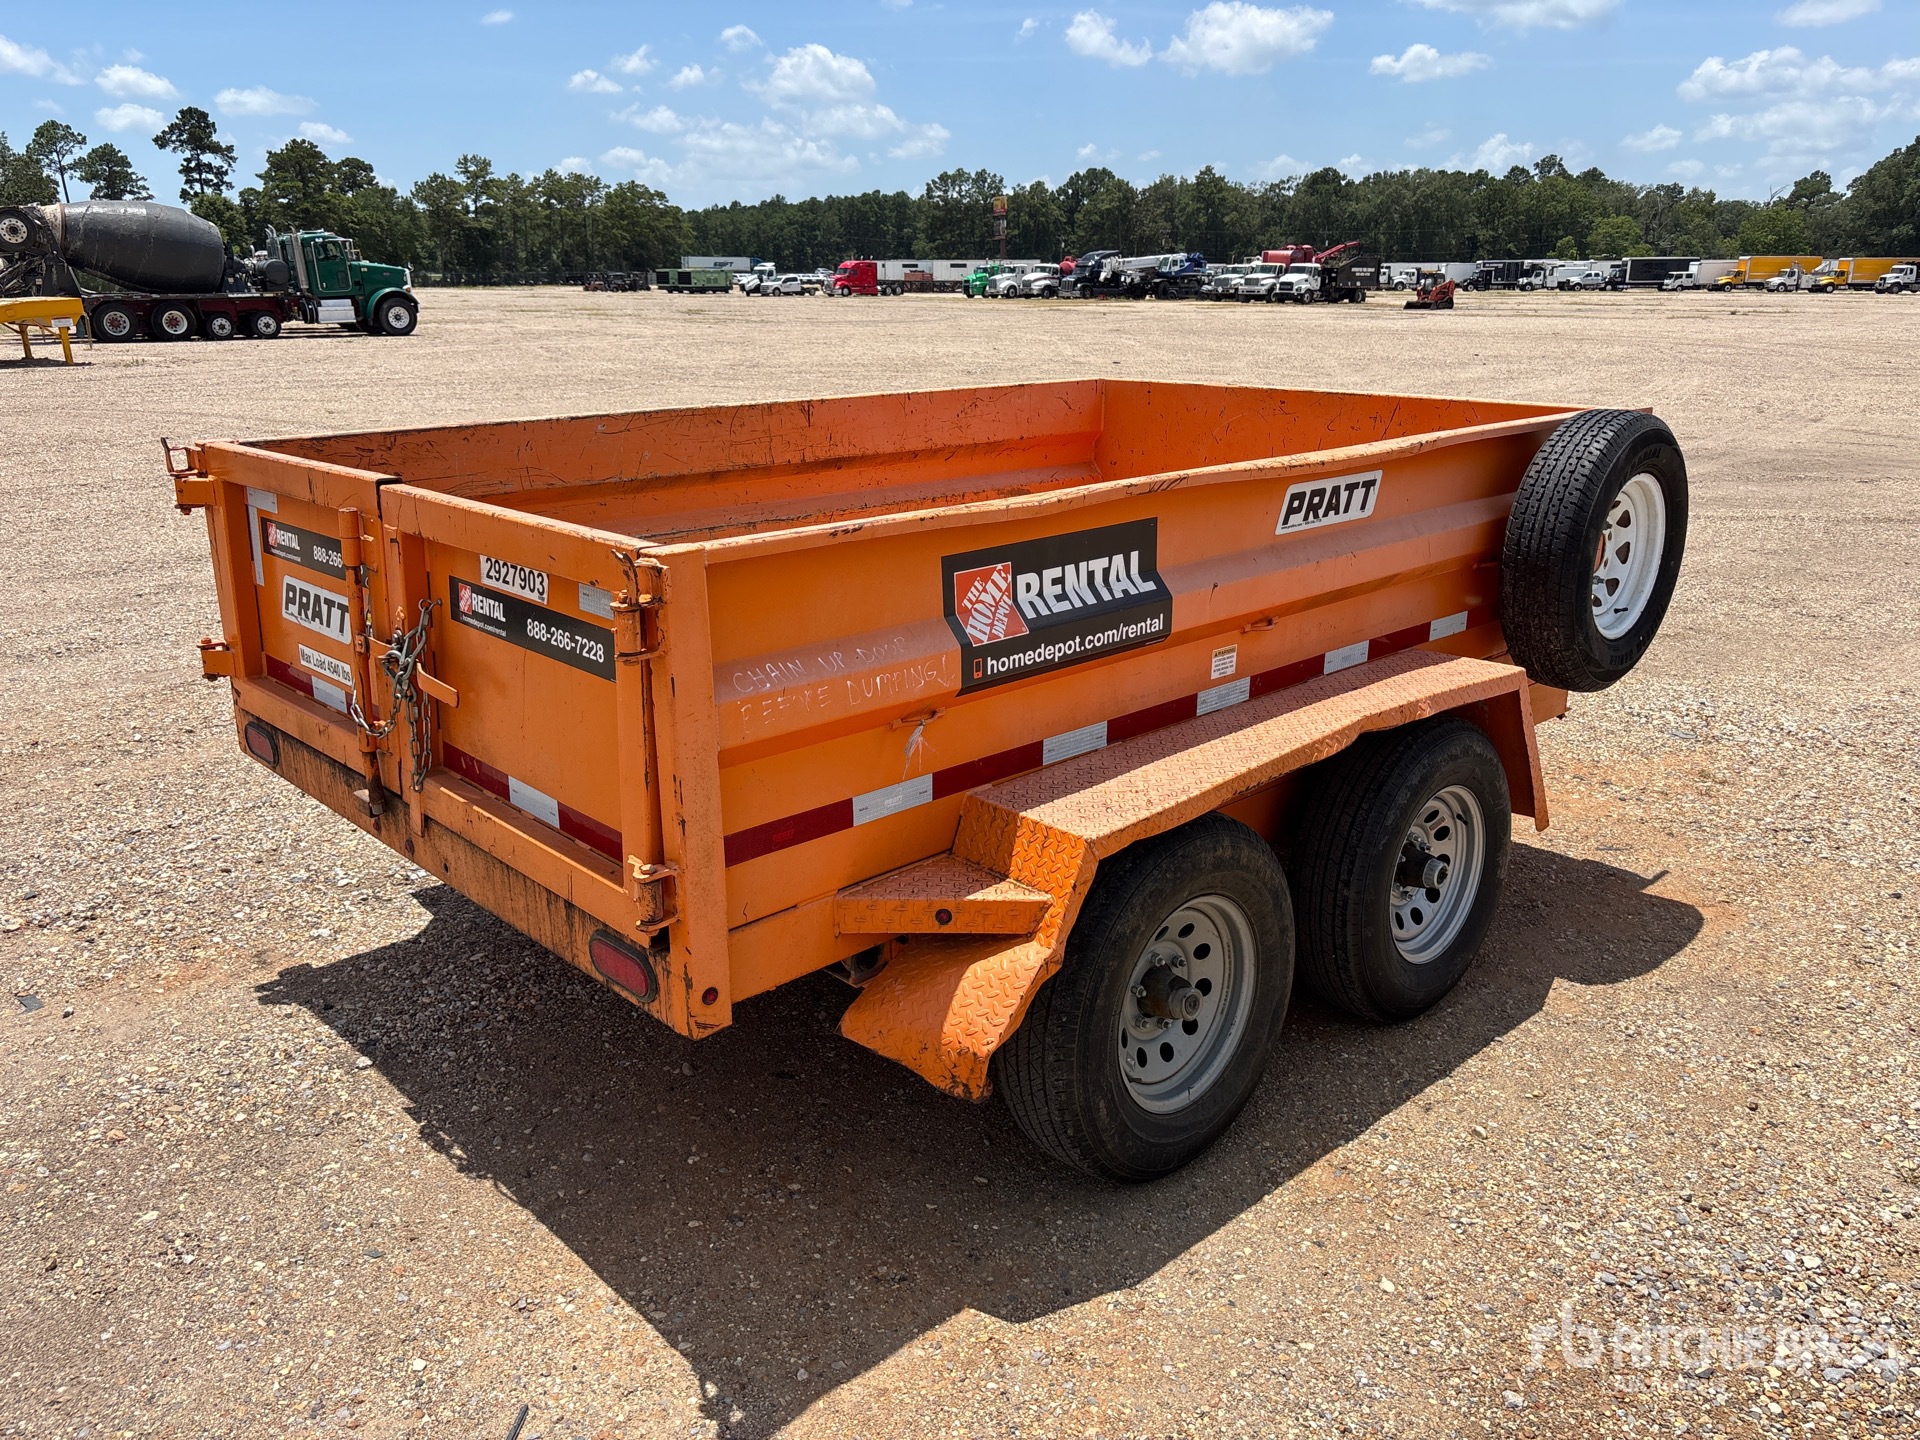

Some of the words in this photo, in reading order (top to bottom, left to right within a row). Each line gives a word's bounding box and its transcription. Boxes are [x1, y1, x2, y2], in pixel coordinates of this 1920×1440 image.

[1282, 479, 1377, 526] PRATT
[276, 528, 300, 550] RENTAL
[313, 545, 343, 568] 888-266
[485, 557, 545, 596] 2927903
[961, 577, 986, 611] THE
[1016, 550, 1157, 620] RENTAL
[285, 582, 349, 634] PRATT
[471, 592, 506, 622] RENTAL
[966, 563, 1012, 643] HOME
[991, 592, 1013, 639] DEPOT
[526, 618, 605, 663] 888-266-7228
[987, 613, 1164, 675] homedepot.com/rental
[300, 647, 312, 664] Max
[312, 653, 327, 671] Load
[327, 660, 341, 677] 4540
[341, 665, 351, 682] lbs
[732, 659, 805, 692] CHAIN
[818, 651, 845, 672] UP
